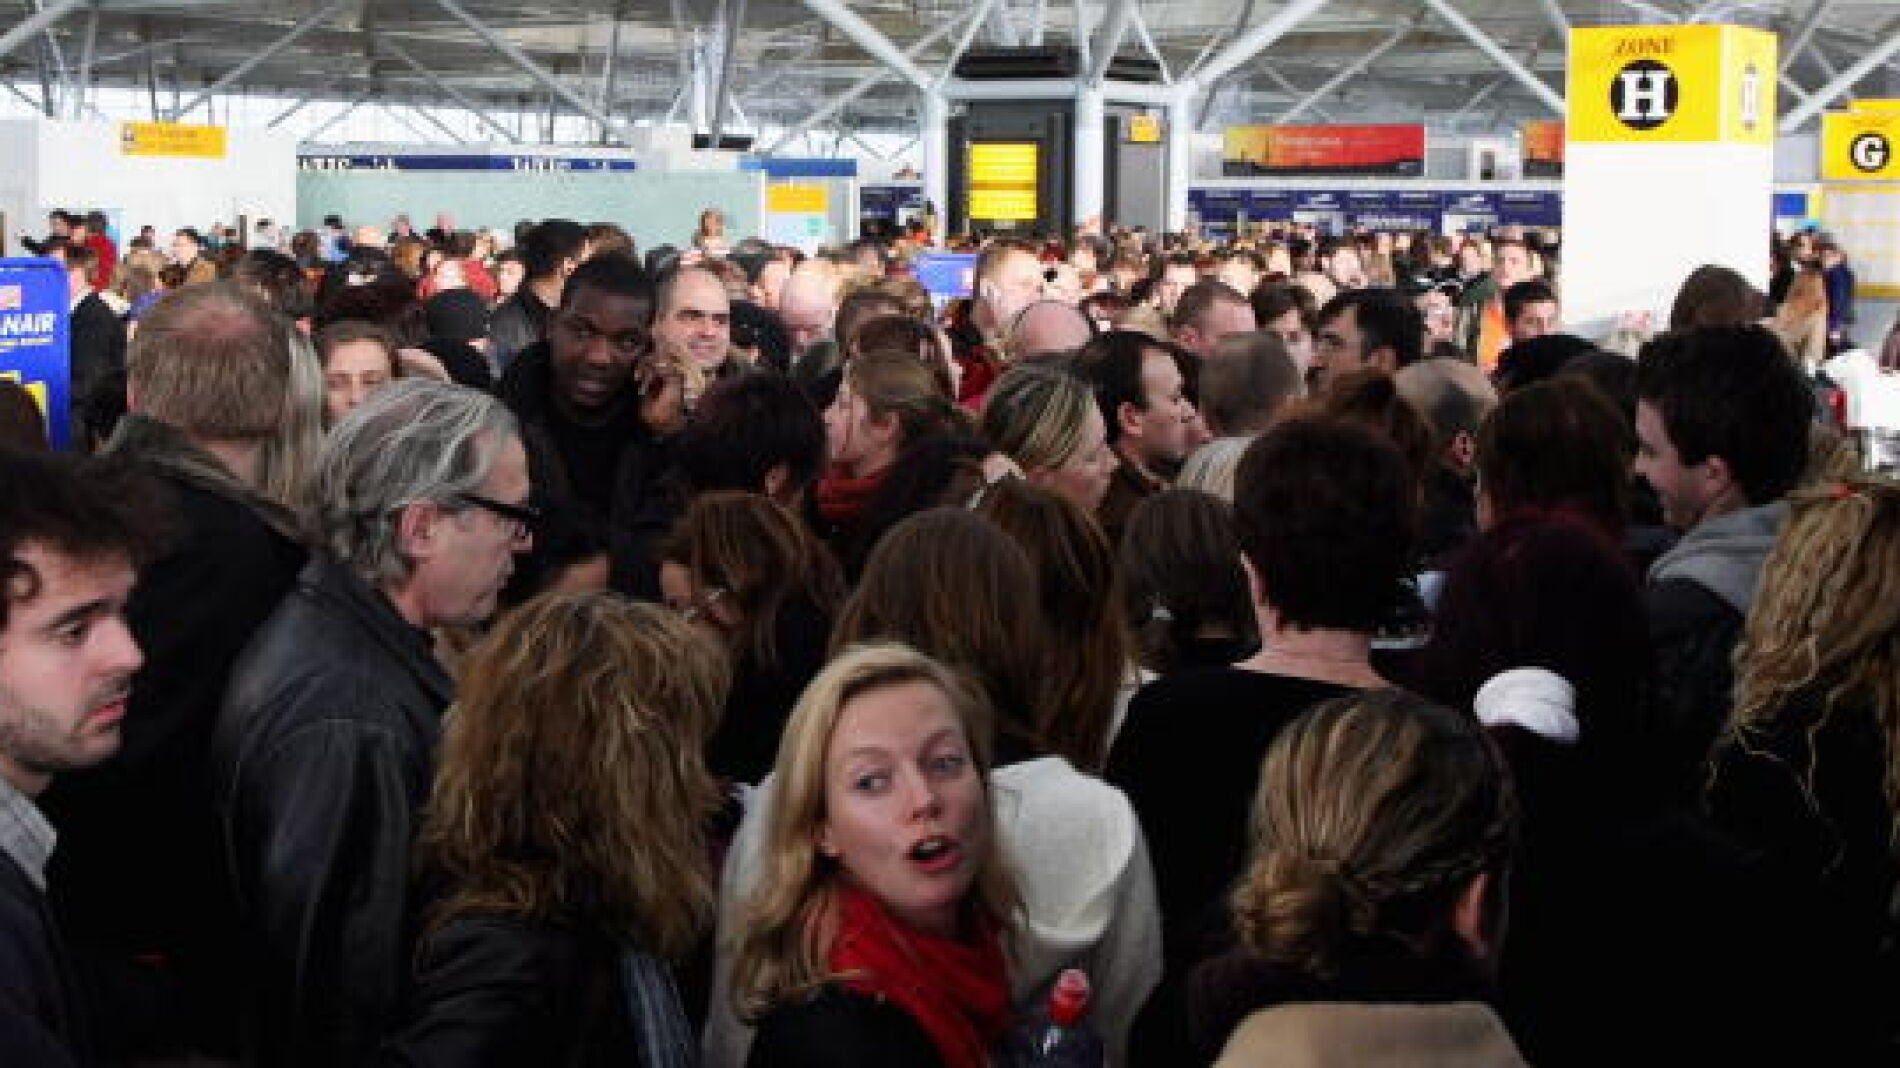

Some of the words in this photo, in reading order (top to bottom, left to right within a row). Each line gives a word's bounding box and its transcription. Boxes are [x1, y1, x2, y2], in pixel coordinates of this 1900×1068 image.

[1615, 37, 1675, 55] ZONE
[1616, 69, 1671, 121] H
[1853, 135, 1886, 169] G
[0, 312, 57, 336] NAIR
